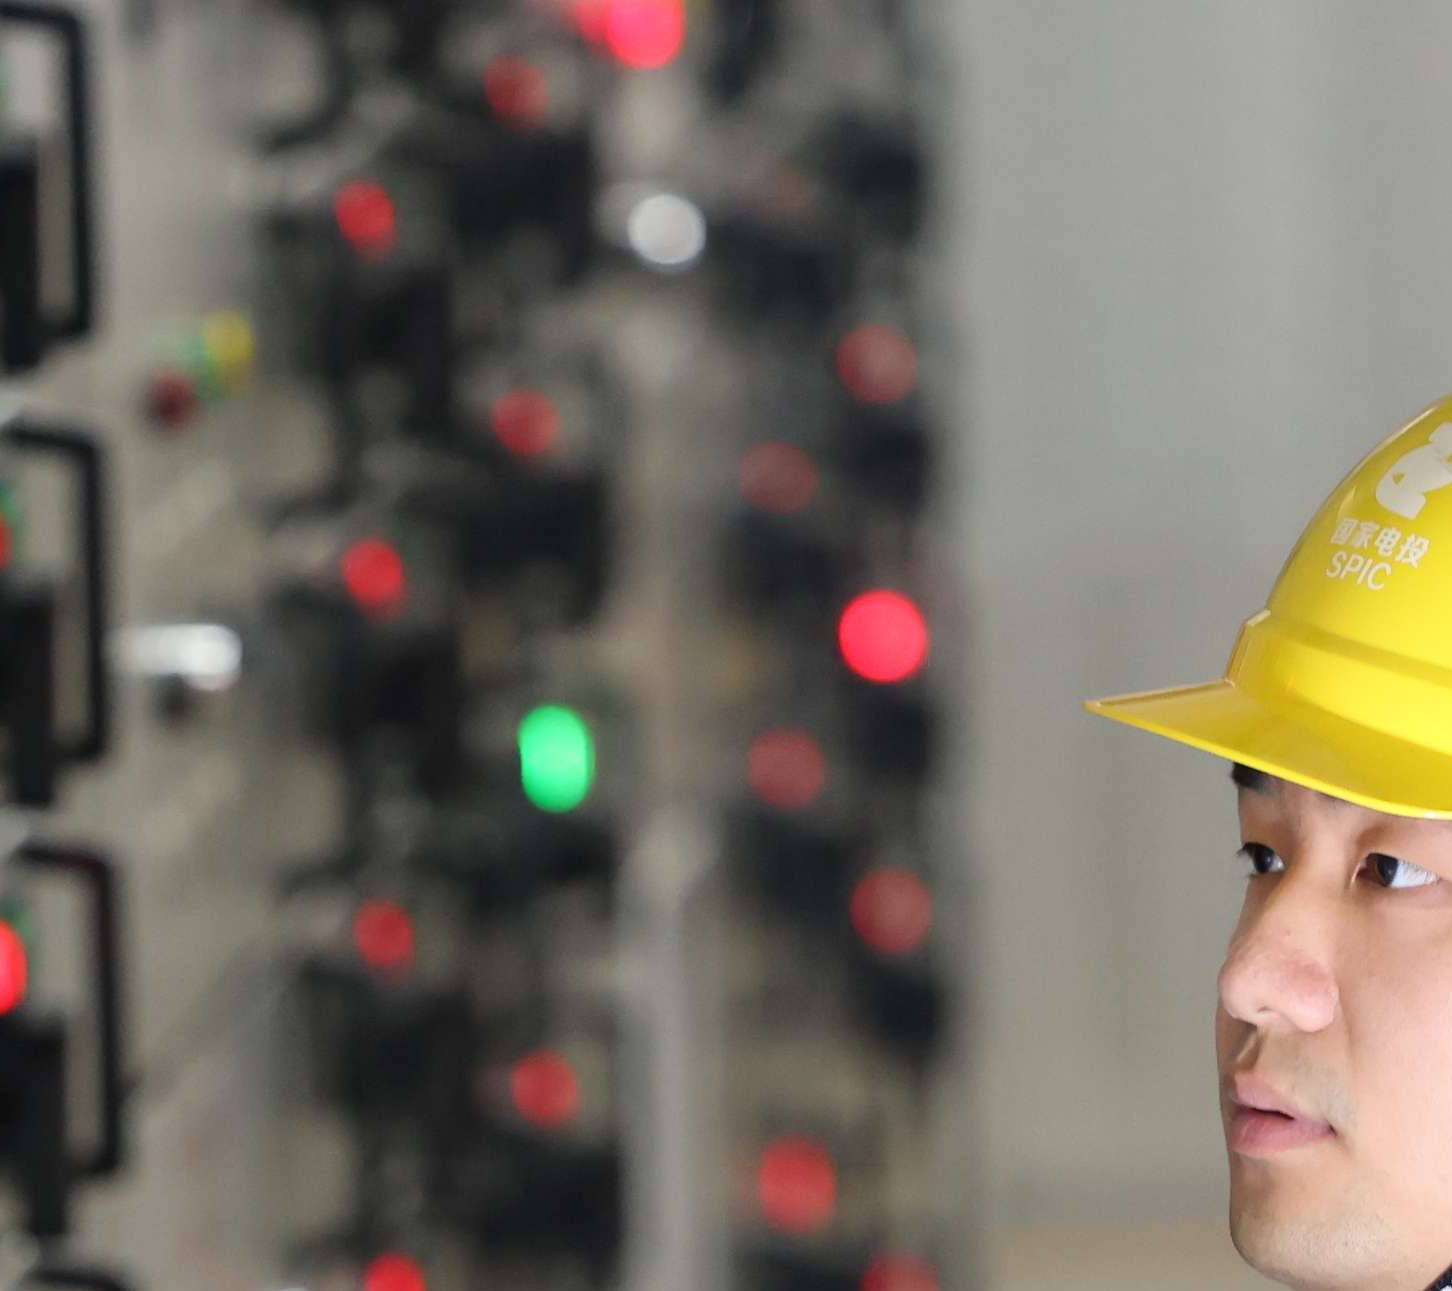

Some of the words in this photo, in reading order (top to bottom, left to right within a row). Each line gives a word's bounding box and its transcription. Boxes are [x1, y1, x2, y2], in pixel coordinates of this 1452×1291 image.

[1330, 516, 1431, 569] 国家电投
[1325, 550, 1393, 592] SPIC
